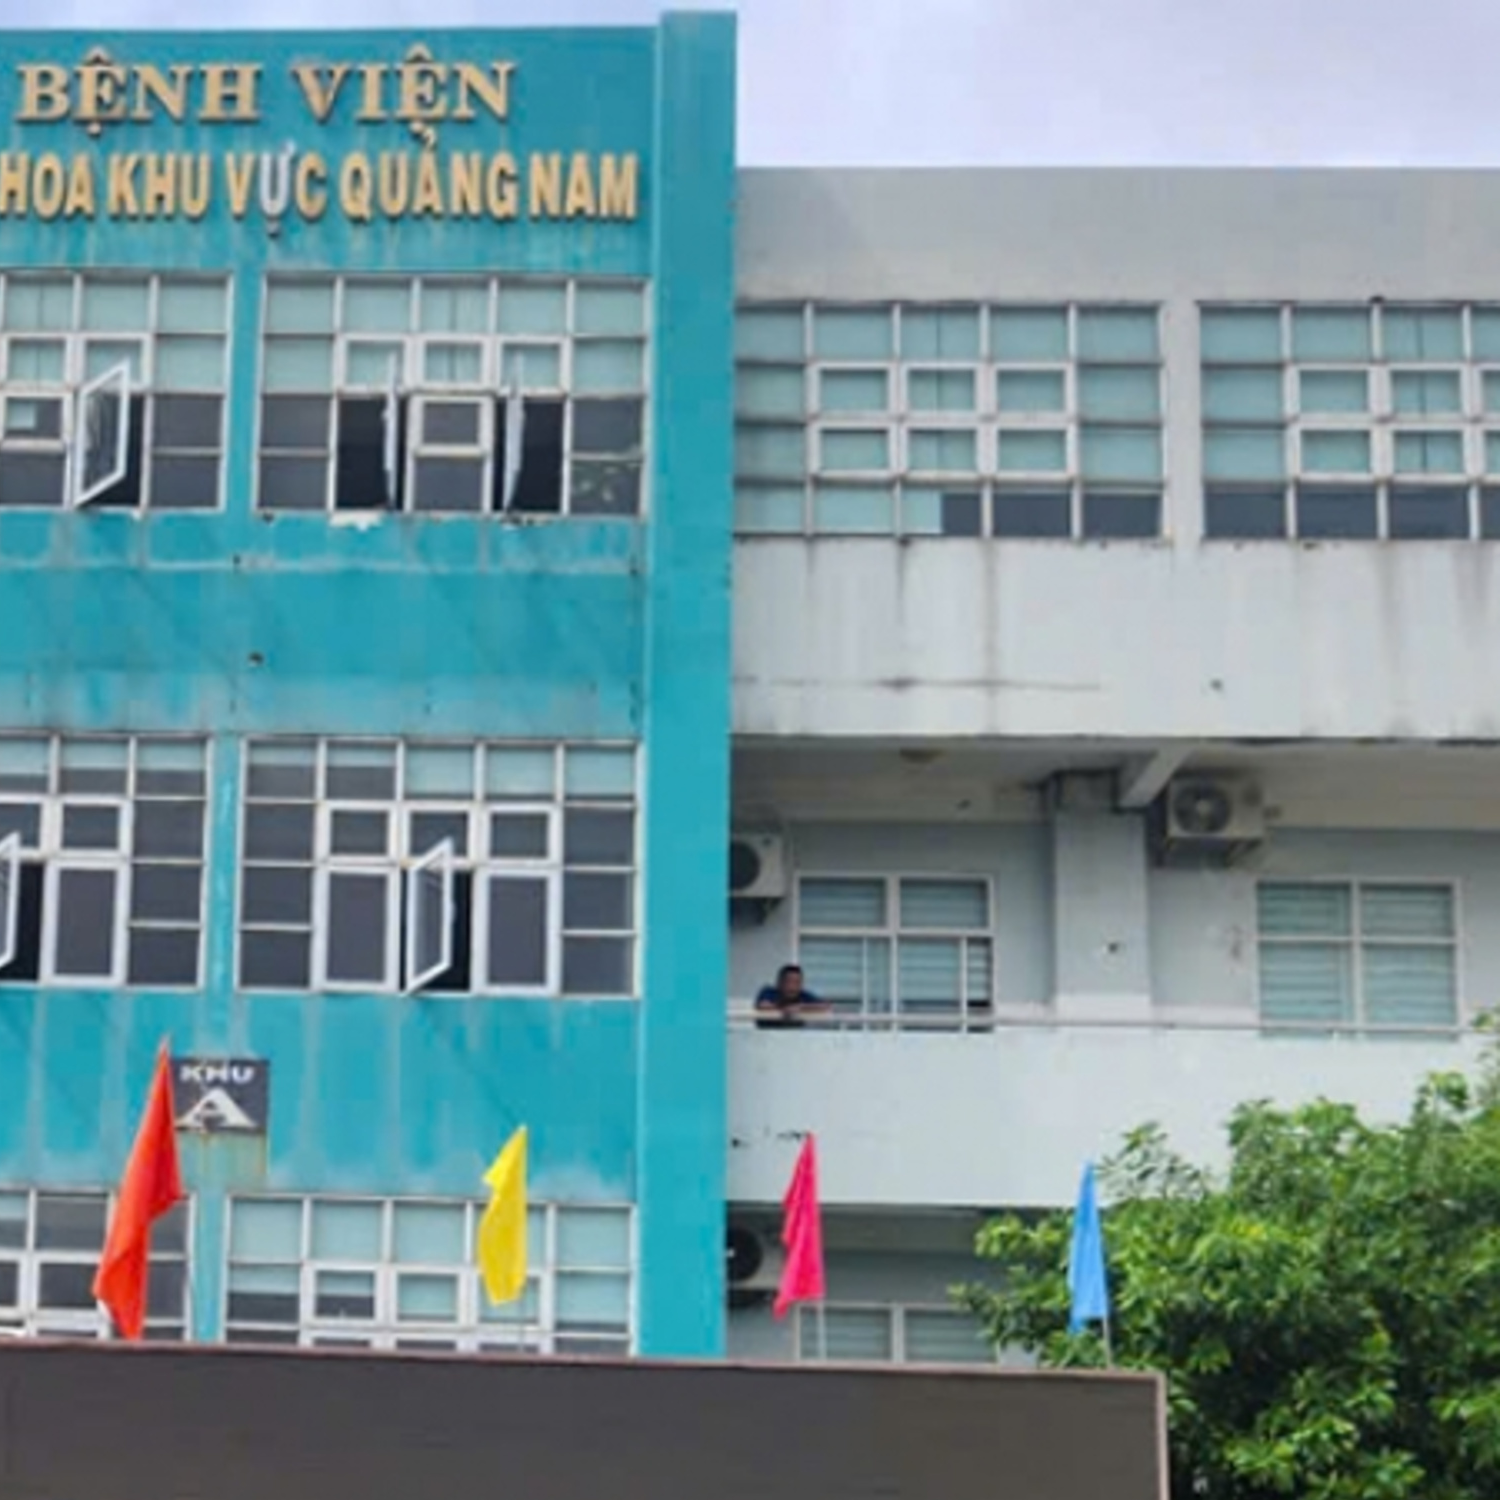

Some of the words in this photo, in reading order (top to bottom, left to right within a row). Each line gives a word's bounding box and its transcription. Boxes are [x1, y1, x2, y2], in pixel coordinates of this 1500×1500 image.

[15, 46, 263, 136] BỆNH
[288, 42, 518, 134] VIỆN
[108, 150, 210, 219] KHU
[225, 139, 328, 237] VỰC
[339, 124, 519, 224] QUẢNG
[528, 151, 640, 221] NAM
[180, 1064, 255, 1084] KHU
